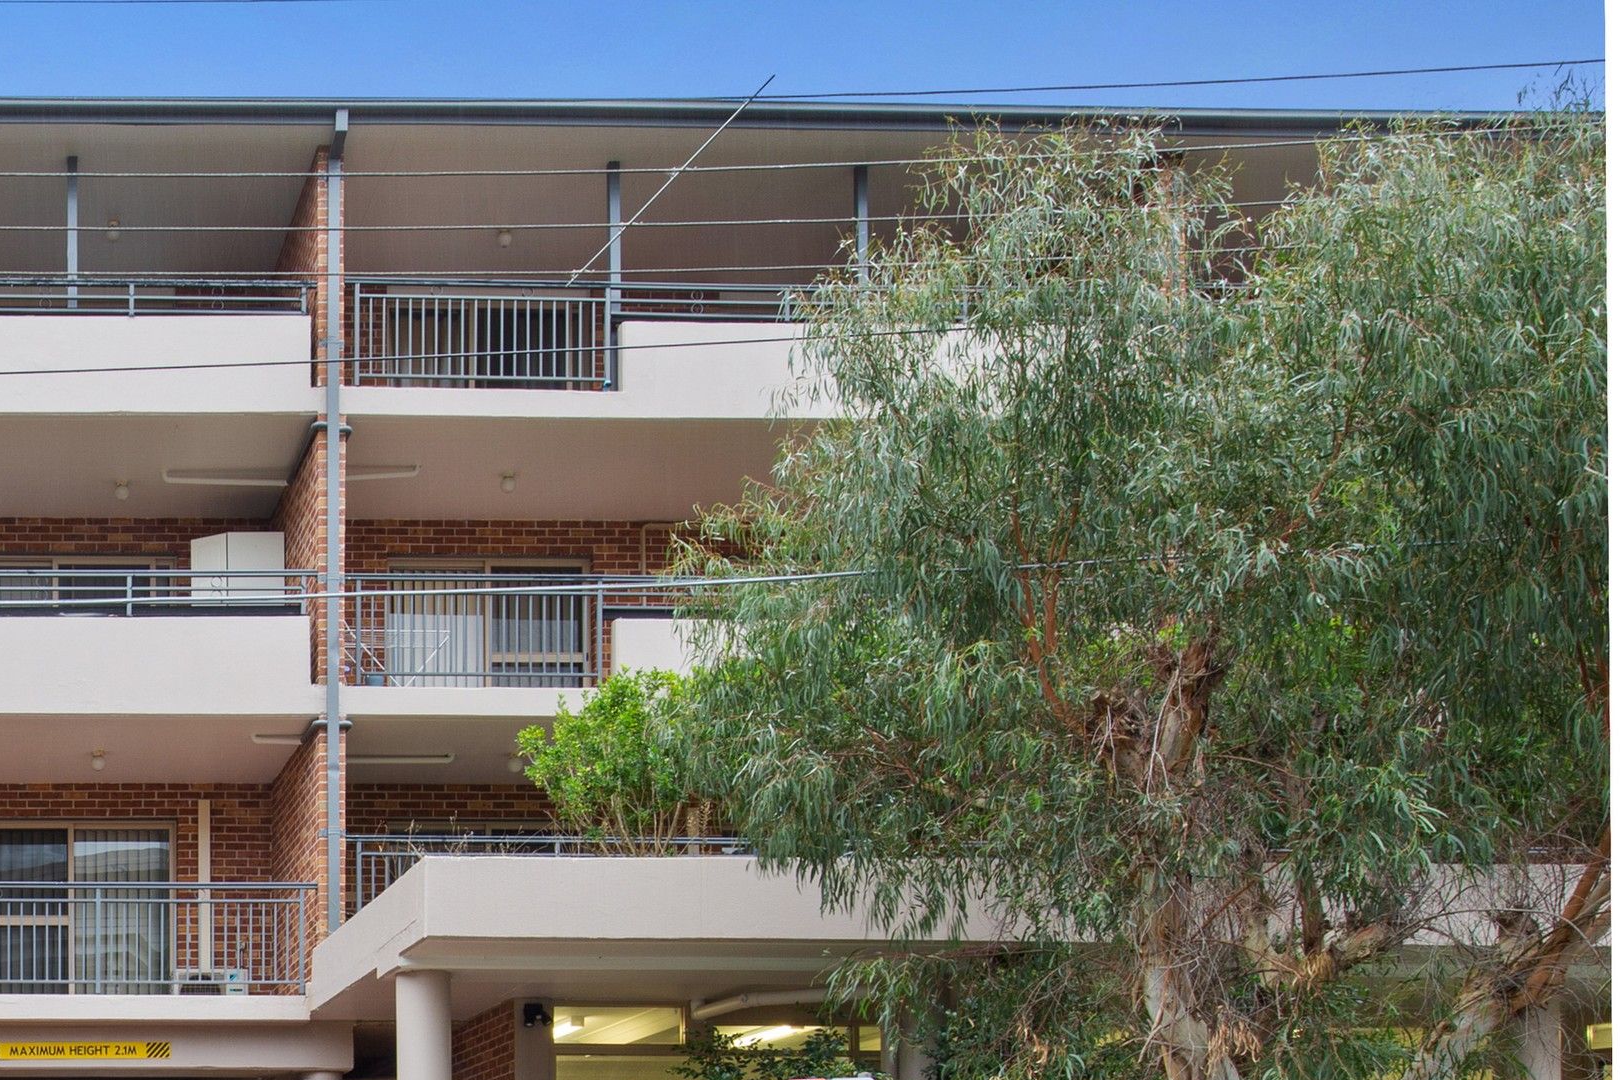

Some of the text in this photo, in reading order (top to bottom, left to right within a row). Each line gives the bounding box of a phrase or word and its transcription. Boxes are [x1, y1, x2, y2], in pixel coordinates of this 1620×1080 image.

[9, 1045, 137, 1057] MAXIMUM HEIGHT 2.1M
